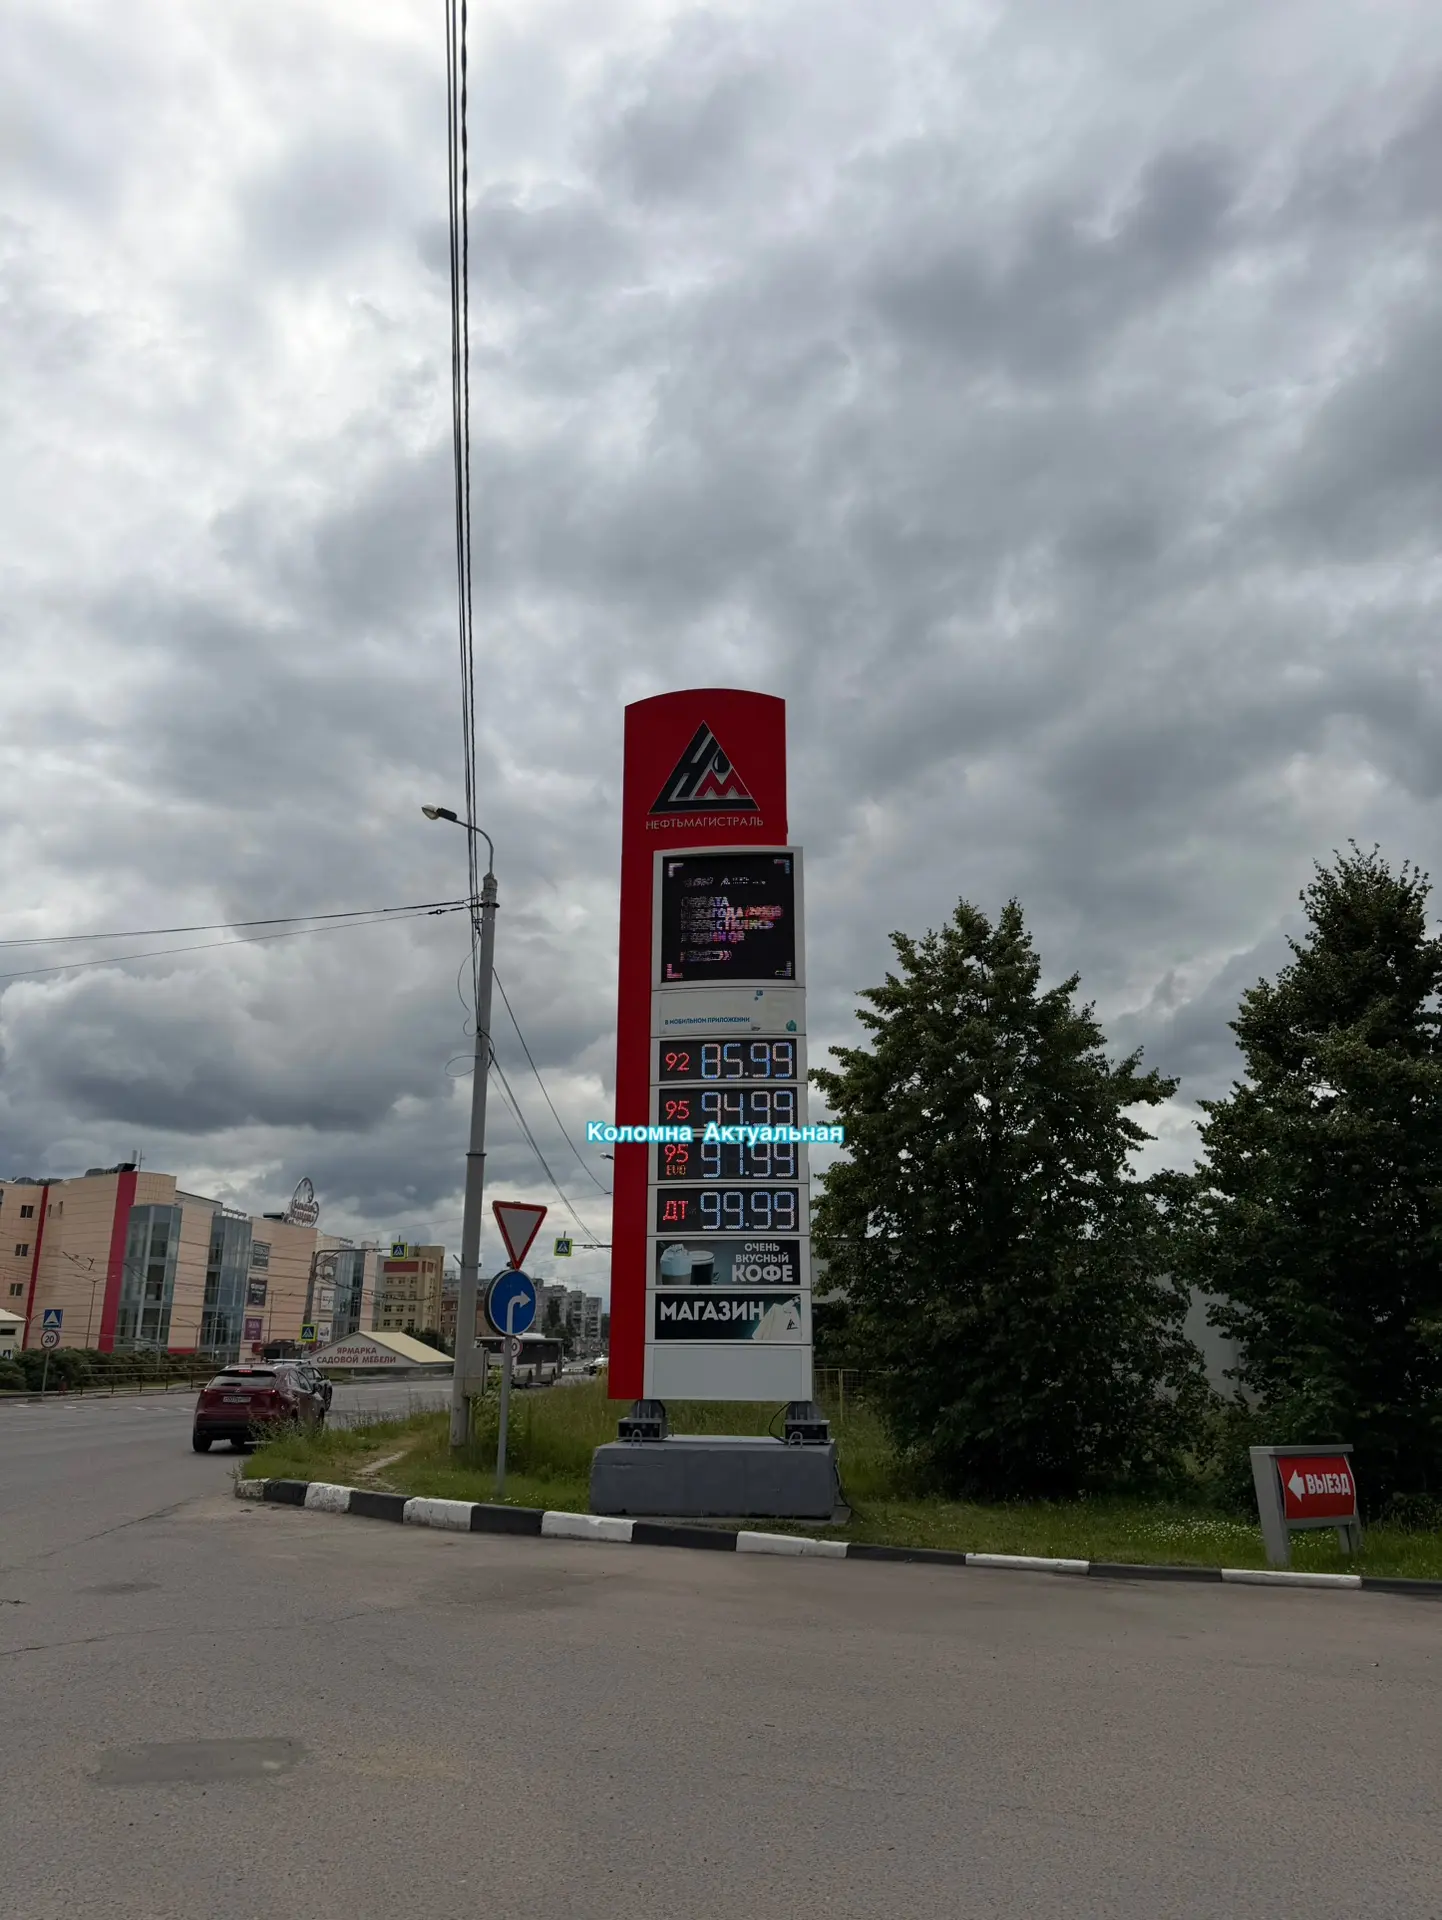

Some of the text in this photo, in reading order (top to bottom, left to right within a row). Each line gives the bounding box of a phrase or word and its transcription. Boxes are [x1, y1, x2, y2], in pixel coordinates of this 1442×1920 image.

[645, 816, 764, 830] НЕФТЬМАГИСТРАЛЬ
[669, 1017, 706, 1025] МОБИЛЬНОМ
[707, 1016, 750, 1024] ПРИЛОЖЕНИИ
[665, 1042, 793, 1079] 92 85.99
[665, 1090, 794, 1127] 95 94.99
[664, 1140, 794, 1178] 95 97.99
[662, 1191, 795, 1230] ДТ 99.99
[744, 1243, 780, 1252] ОЧЕНЬ
[735, 1252, 790, 1264] ВКУСНЫЙ
[731, 1264, 794, 1283] КОФЕ
[660, 1301, 765, 1321] МАГАЗИН
[44, 1335, 55, 1343] 20
[336, 1346, 377, 1355] ЯРМАРКА
[316, 1355, 397, 1364] САДОВОЙ МЕБЕЛИ
[1305, 1473, 1351, 1495] ВЫЕЗД
